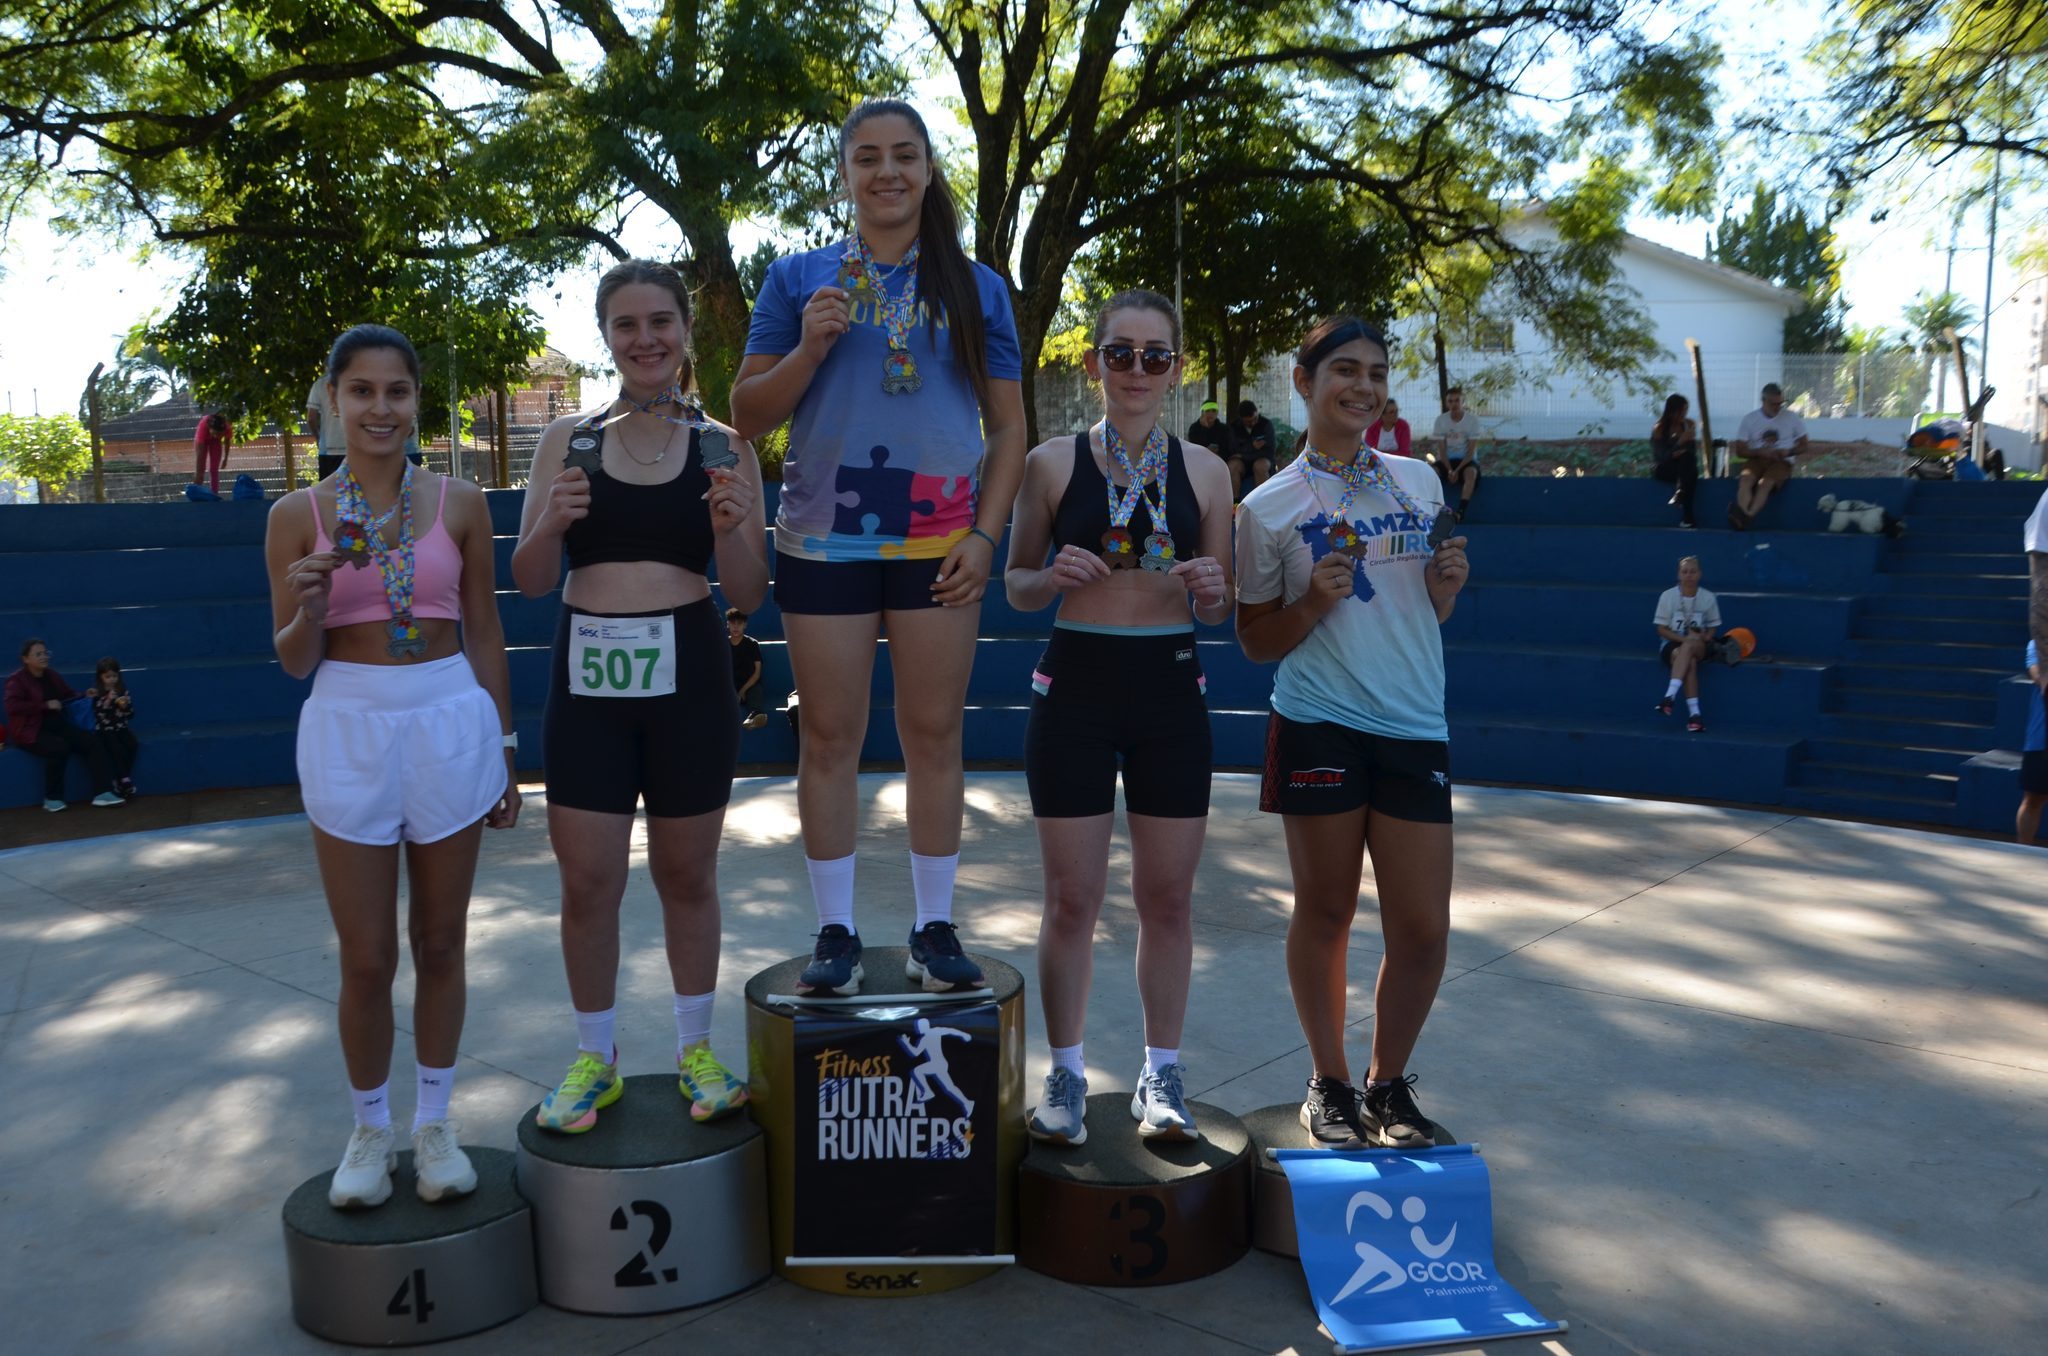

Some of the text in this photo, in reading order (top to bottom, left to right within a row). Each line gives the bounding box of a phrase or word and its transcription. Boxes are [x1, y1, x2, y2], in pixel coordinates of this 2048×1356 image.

[582, 646, 660, 690] 507
[815, 1048, 891, 1080] Fitness
[818, 1075, 926, 1119] DUTRA
[818, 1117, 973, 1160] RUNNERS
[610, 1200, 678, 1288] 2
[1109, 1195, 1168, 1280] 3
[1407, 1261, 1487, 1283] GCOR
[1424, 1284, 1498, 1297] Palmitinho
[387, 1268, 434, 1324] 4
